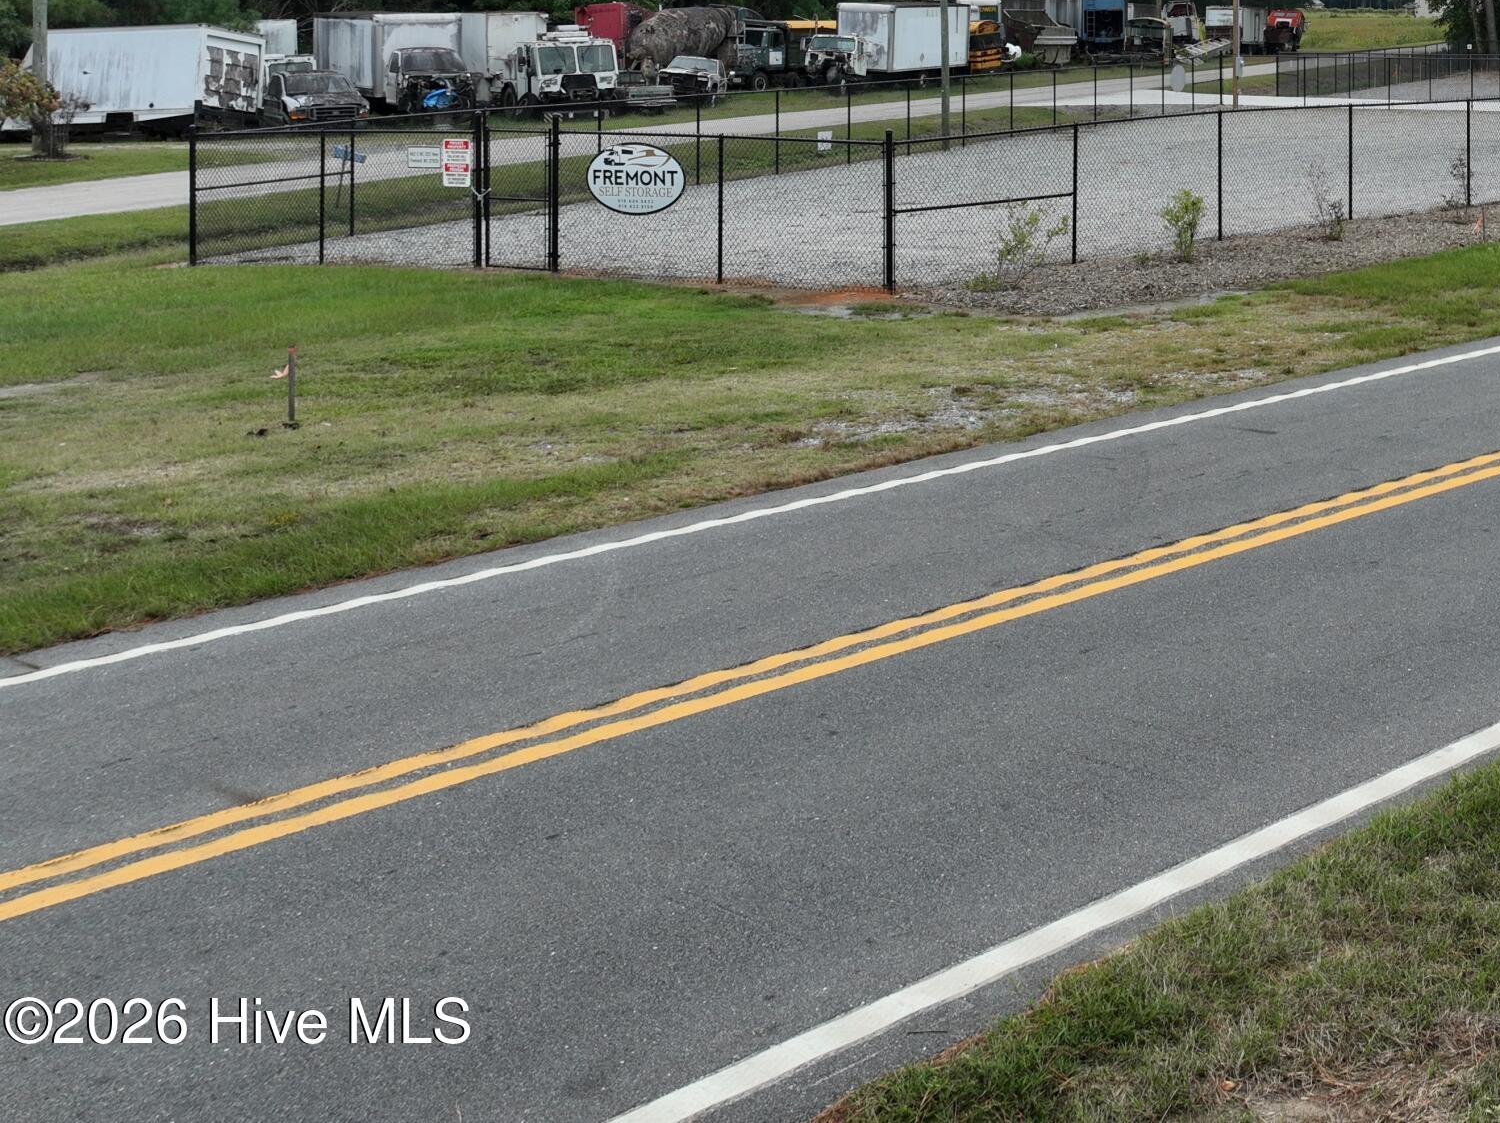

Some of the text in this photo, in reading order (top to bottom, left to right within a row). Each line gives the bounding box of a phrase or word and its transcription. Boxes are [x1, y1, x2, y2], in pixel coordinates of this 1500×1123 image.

[593, 169, 678, 186] FREMONT
[599, 186, 673, 198] SELF STORAGE
